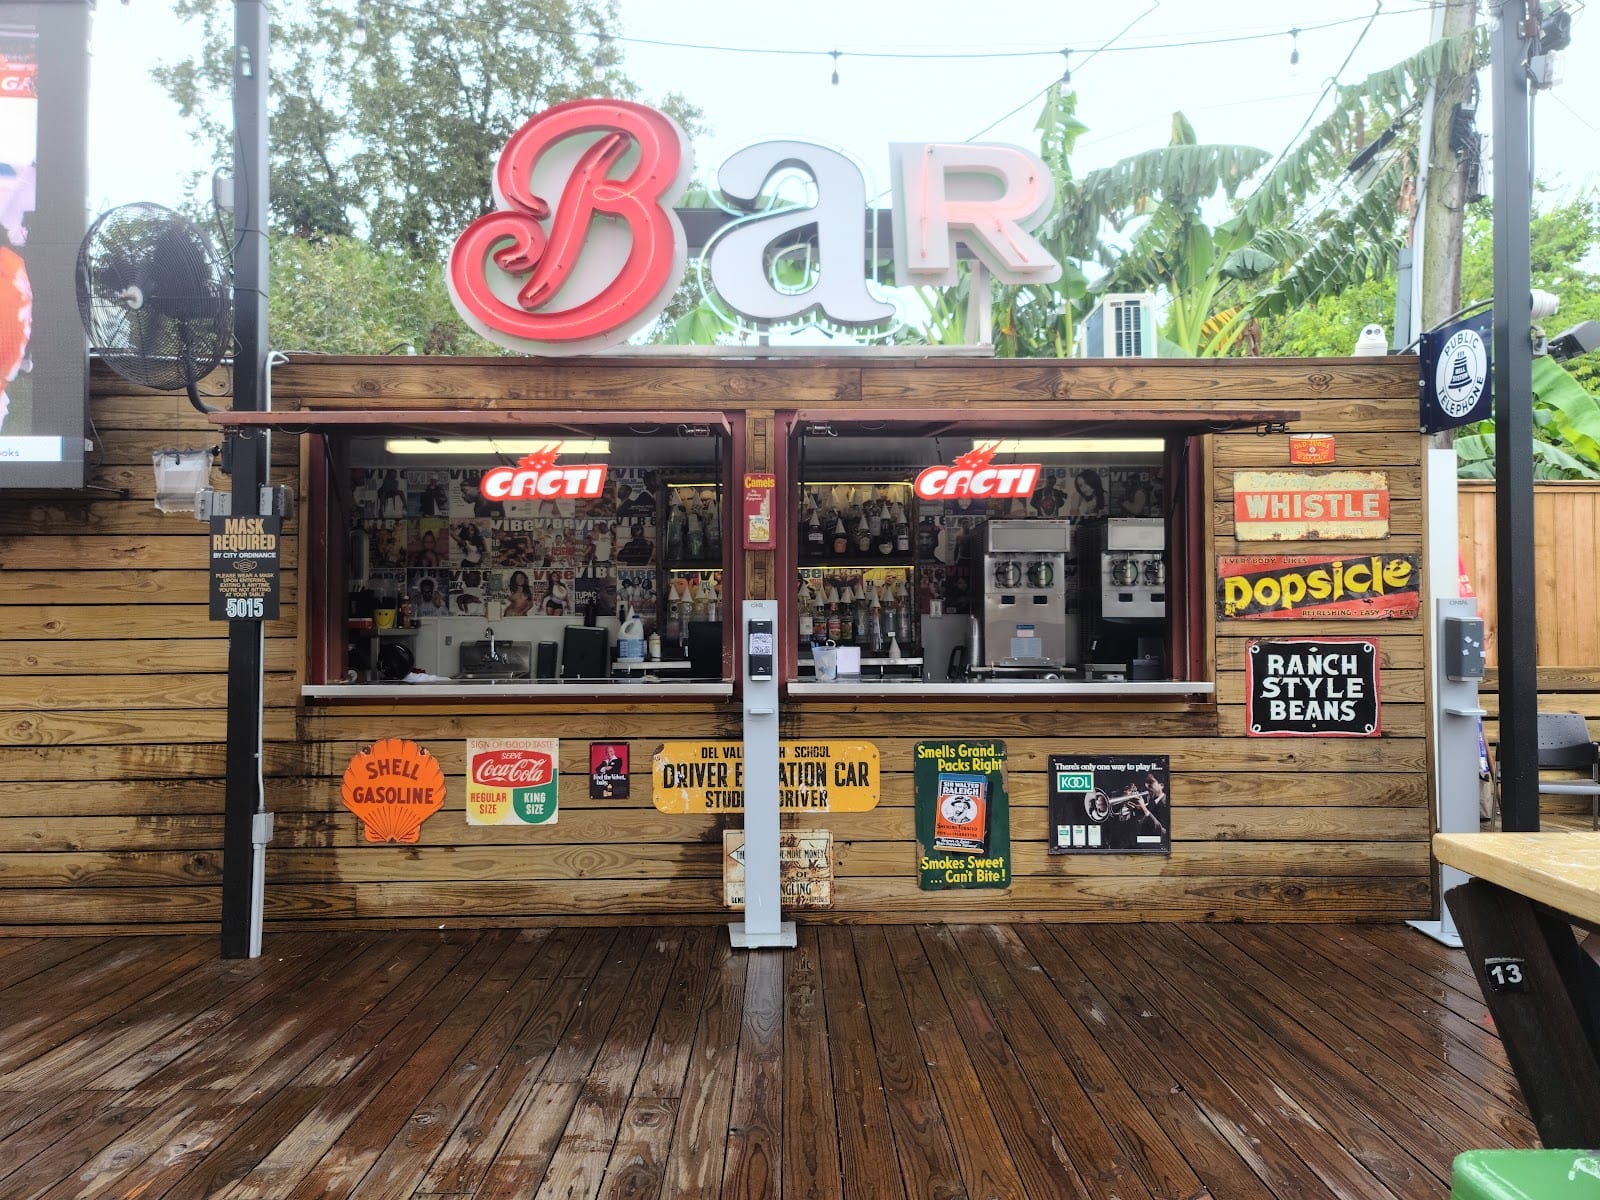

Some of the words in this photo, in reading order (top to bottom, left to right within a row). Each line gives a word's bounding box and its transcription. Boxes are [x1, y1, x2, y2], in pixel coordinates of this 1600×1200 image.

[1444, 332, 1479, 357] PUBLIC
[1438, 376, 1484, 416] TELEPHONE
[485, 469, 602, 496] CACTI
[744, 476, 775, 488] Camels
[919, 469, 1036, 496] CACTI
[1245, 493, 1380, 519] WHISTLE
[225, 518, 264, 534] MASK
[213, 535, 276, 552] REQUIRED
[226, 598, 264, 618] 5015
[1268, 654, 1357, 675] RANCH
[1260, 677, 1365, 698] STYLE
[1270, 700, 1357, 721] BEANS
[471, 741, 489, 749] SIGN
[702, 747, 718, 758] DEL
[795, 746, 830, 757] SCHOOL
[918, 745, 955, 758] Smells
[502, 752, 522, 760] SERVE
[366, 759, 419, 780] SHELL
[938, 759, 970, 771] Packs
[973, 758, 1002, 774] Right
[1081, 763, 1096, 771] only
[1111, 764, 1126, 772] way
[1136, 763, 1151, 772] play
[664, 763, 728, 788] DRIVER
[736, 762, 826, 787] EATION
[835, 762, 869, 786] CAR
[1062, 777, 1090, 788] KOOL
[353, 787, 433, 804] GASOLINE
[471, 793, 506, 803] REGULAR
[524, 793, 545, 803] KING
[943, 787, 979, 795] RALEIGH
[480, 804, 496, 814] SIZE
[526, 804, 543, 814] SIZE
[805, 849, 824, 859] MONEY
[922, 857, 965, 870] Smokes
[967, 856, 1004, 868] Sweet
[1491, 964, 1522, 984] 13
